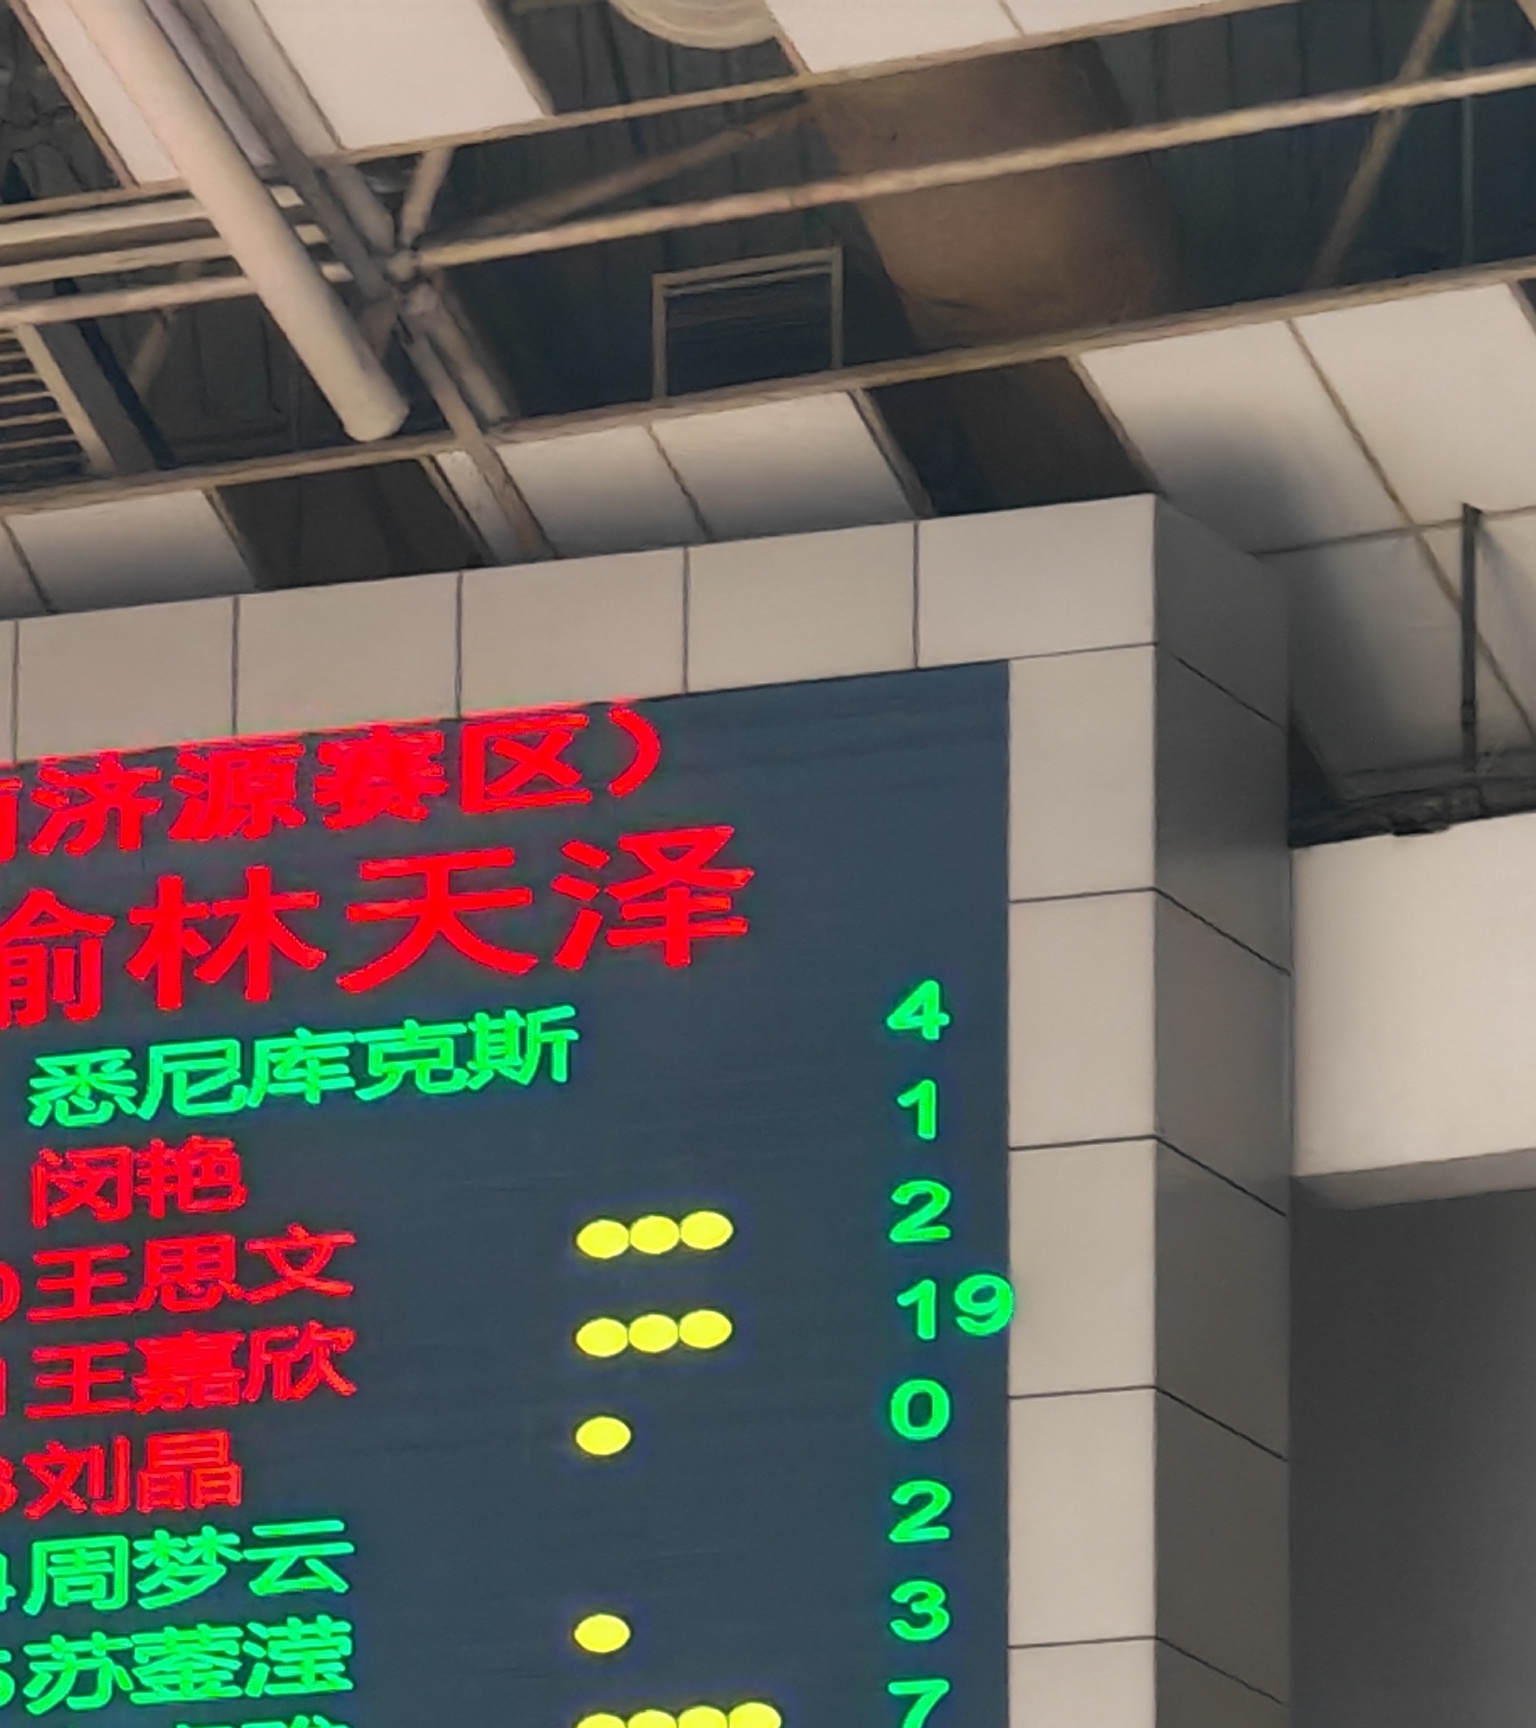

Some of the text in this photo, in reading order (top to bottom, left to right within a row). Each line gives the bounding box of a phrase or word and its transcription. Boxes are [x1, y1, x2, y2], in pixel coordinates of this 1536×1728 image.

[885, 978, 951, 1042] 4
[26, 1003, 580, 1128] 悉尼库克斯
[896, 1078, 938, 1141] 1
[30, 1134, 249, 1230] 闵艳
[888, 1178, 952, 1244] 2
[895, 1272, 1016, 1341] 19
[889, 1378, 951, 1442] 0
[887, 1479, 953, 1544] 2
[889, 1579, 951, 1642] 3
